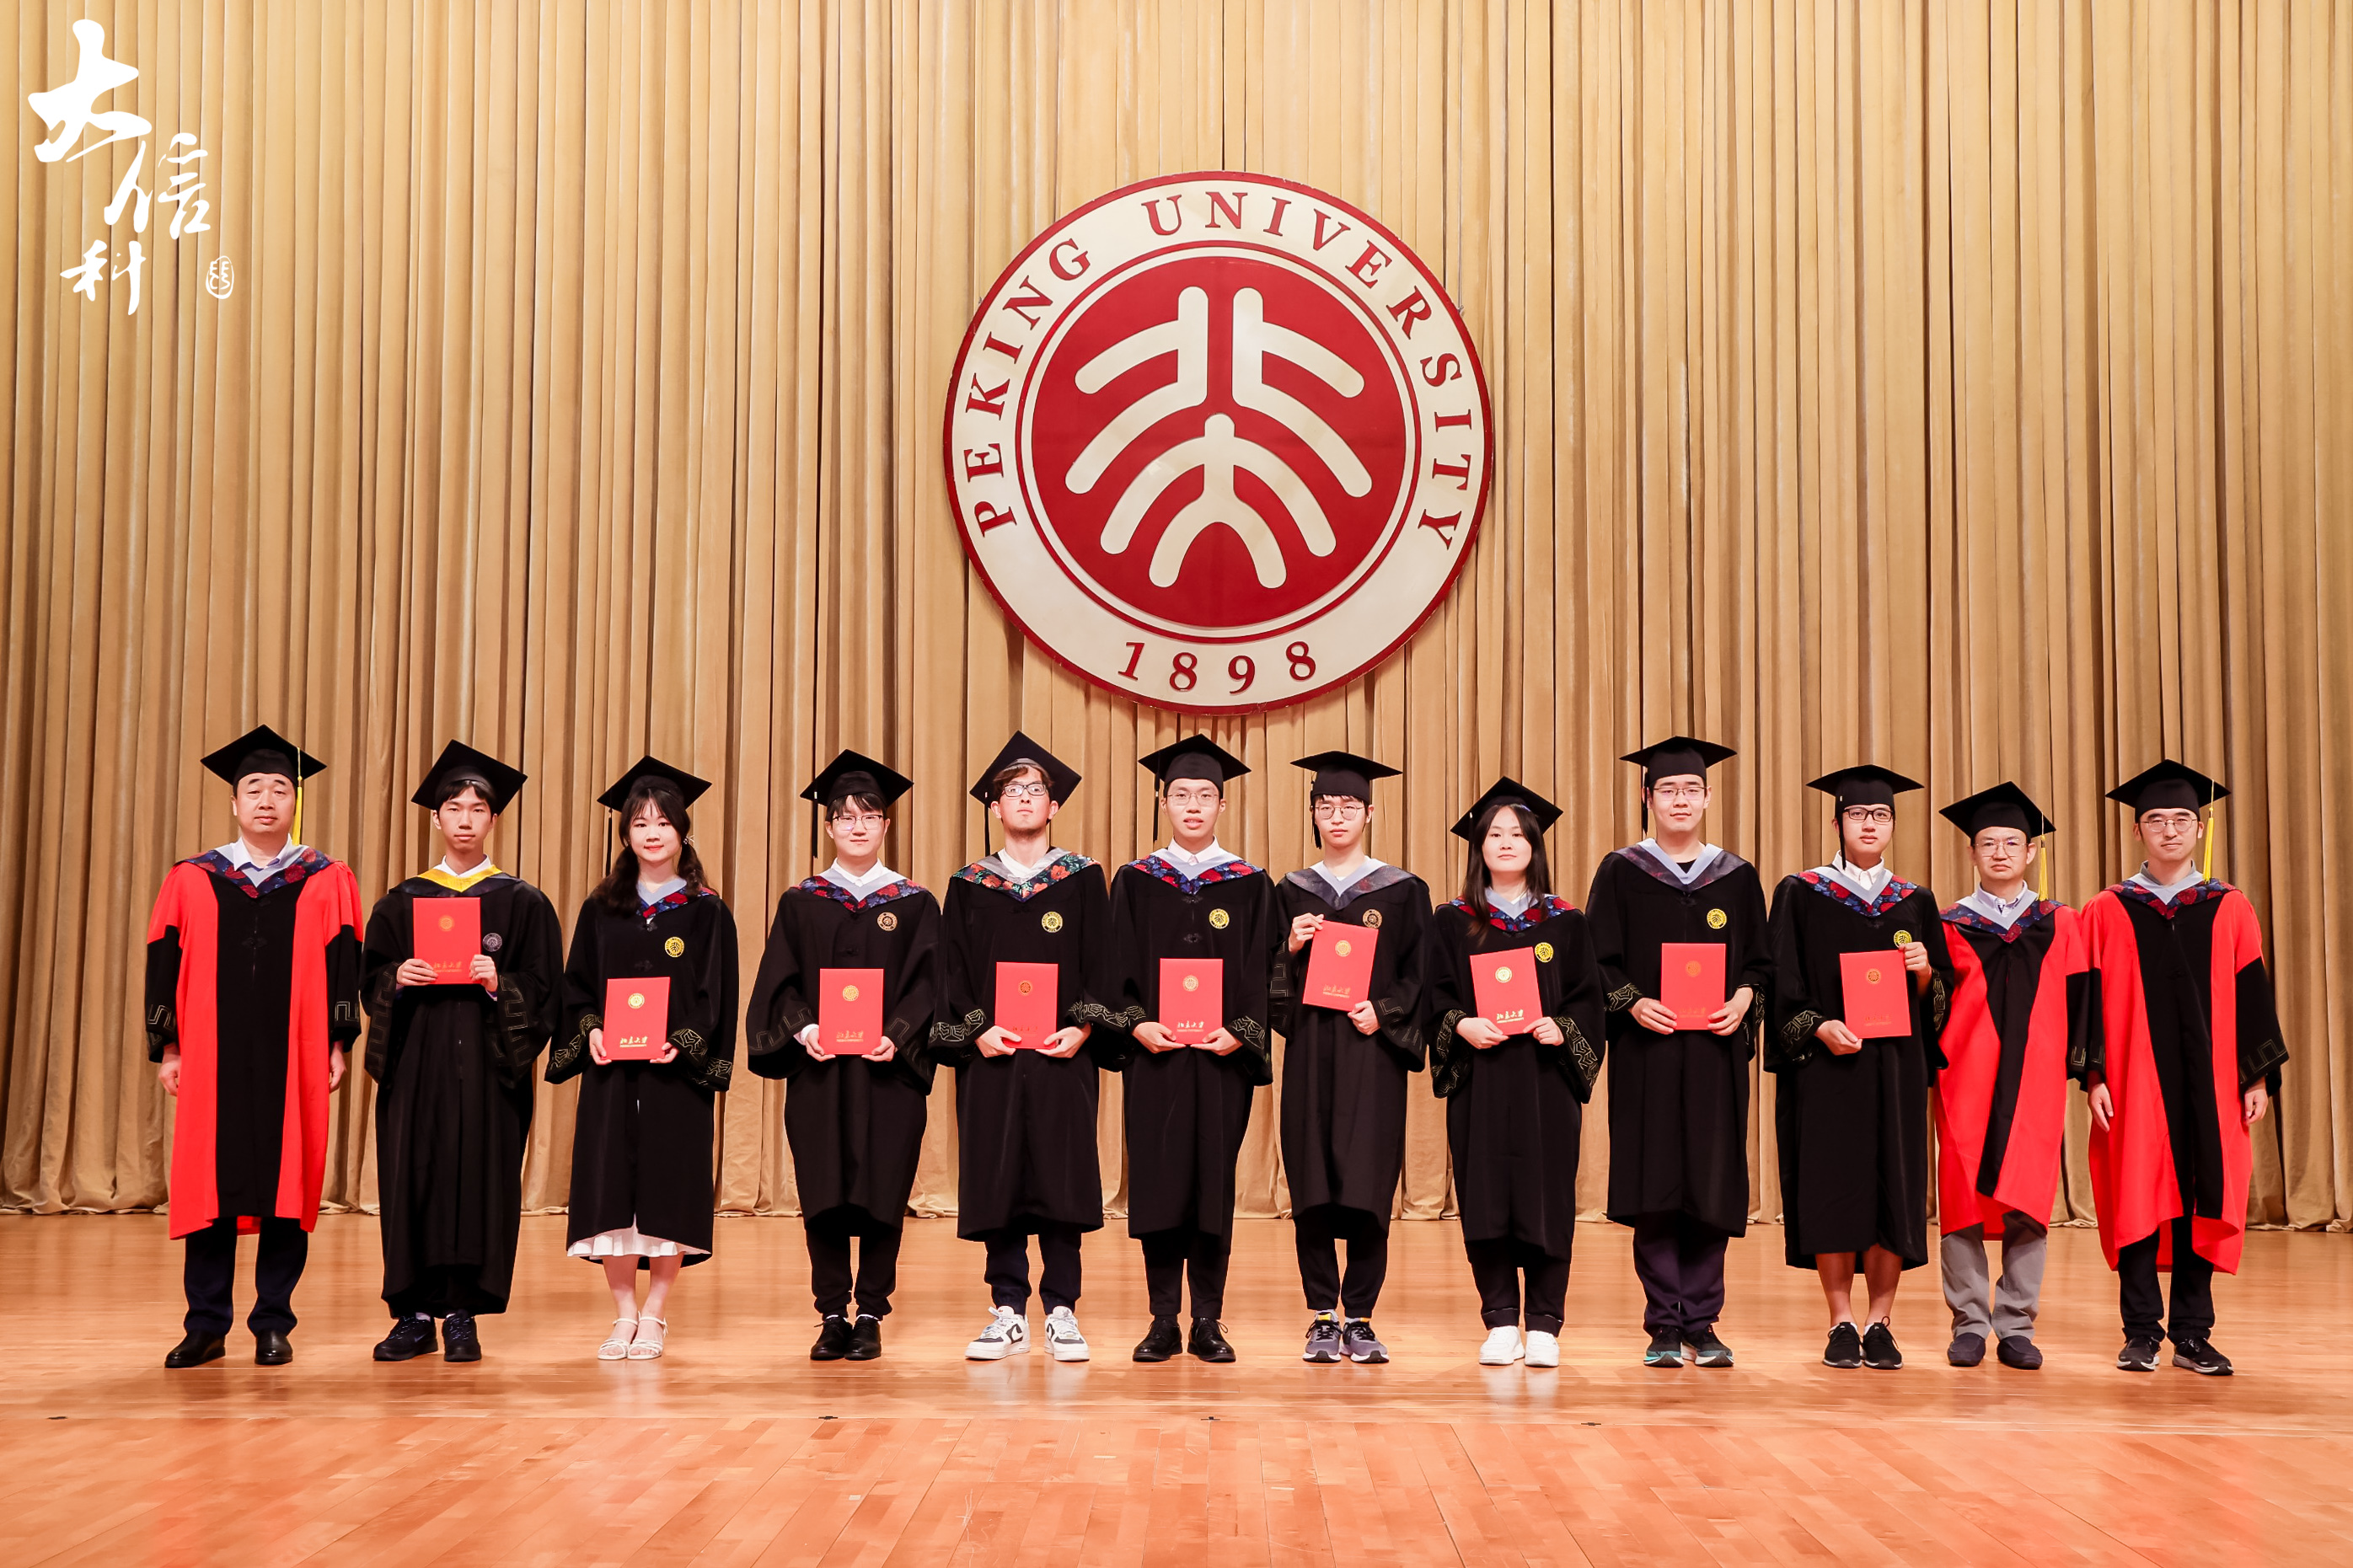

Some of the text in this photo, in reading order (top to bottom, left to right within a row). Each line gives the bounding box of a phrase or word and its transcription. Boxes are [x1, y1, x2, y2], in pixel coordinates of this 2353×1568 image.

[963, 190, 1473, 549] PEKING UNIVERSITY
[1118, 640, 1317, 694] 1898
